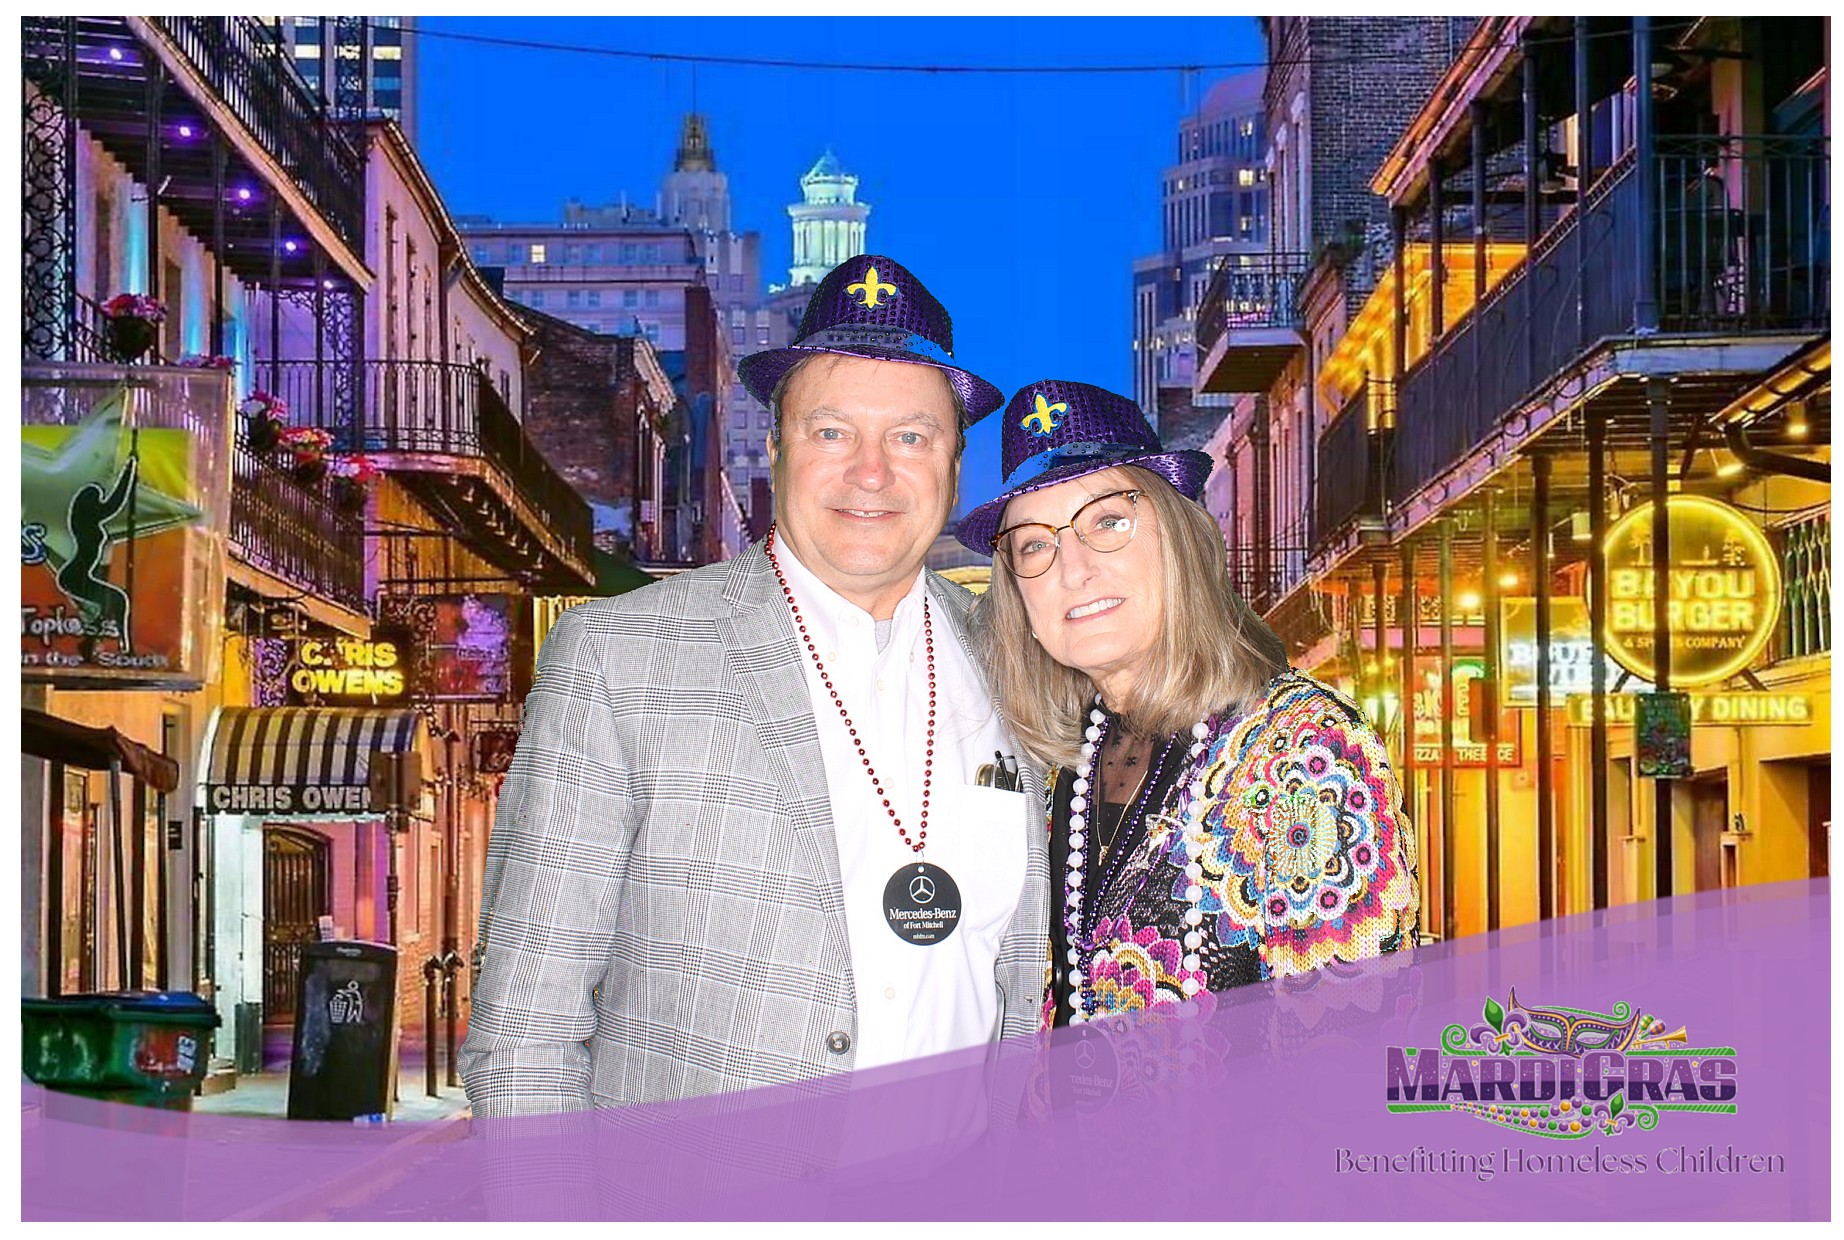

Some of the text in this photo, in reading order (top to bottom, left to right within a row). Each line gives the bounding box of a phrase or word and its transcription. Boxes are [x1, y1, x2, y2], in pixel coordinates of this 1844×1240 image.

[1686, 635, 1746, 649] COMPANY
[301, 641, 397, 667] CRIS
[292, 669, 404, 695] OWENS
[1711, 696, 1808, 721] DINING
[1414, 748, 1441, 761] IZZA
[213, 785, 372, 810] CHRIS OWEN
[889, 907, 957, 920] Mercedes-Benz
[903, 920, 944, 929] of Fort Mitchell
